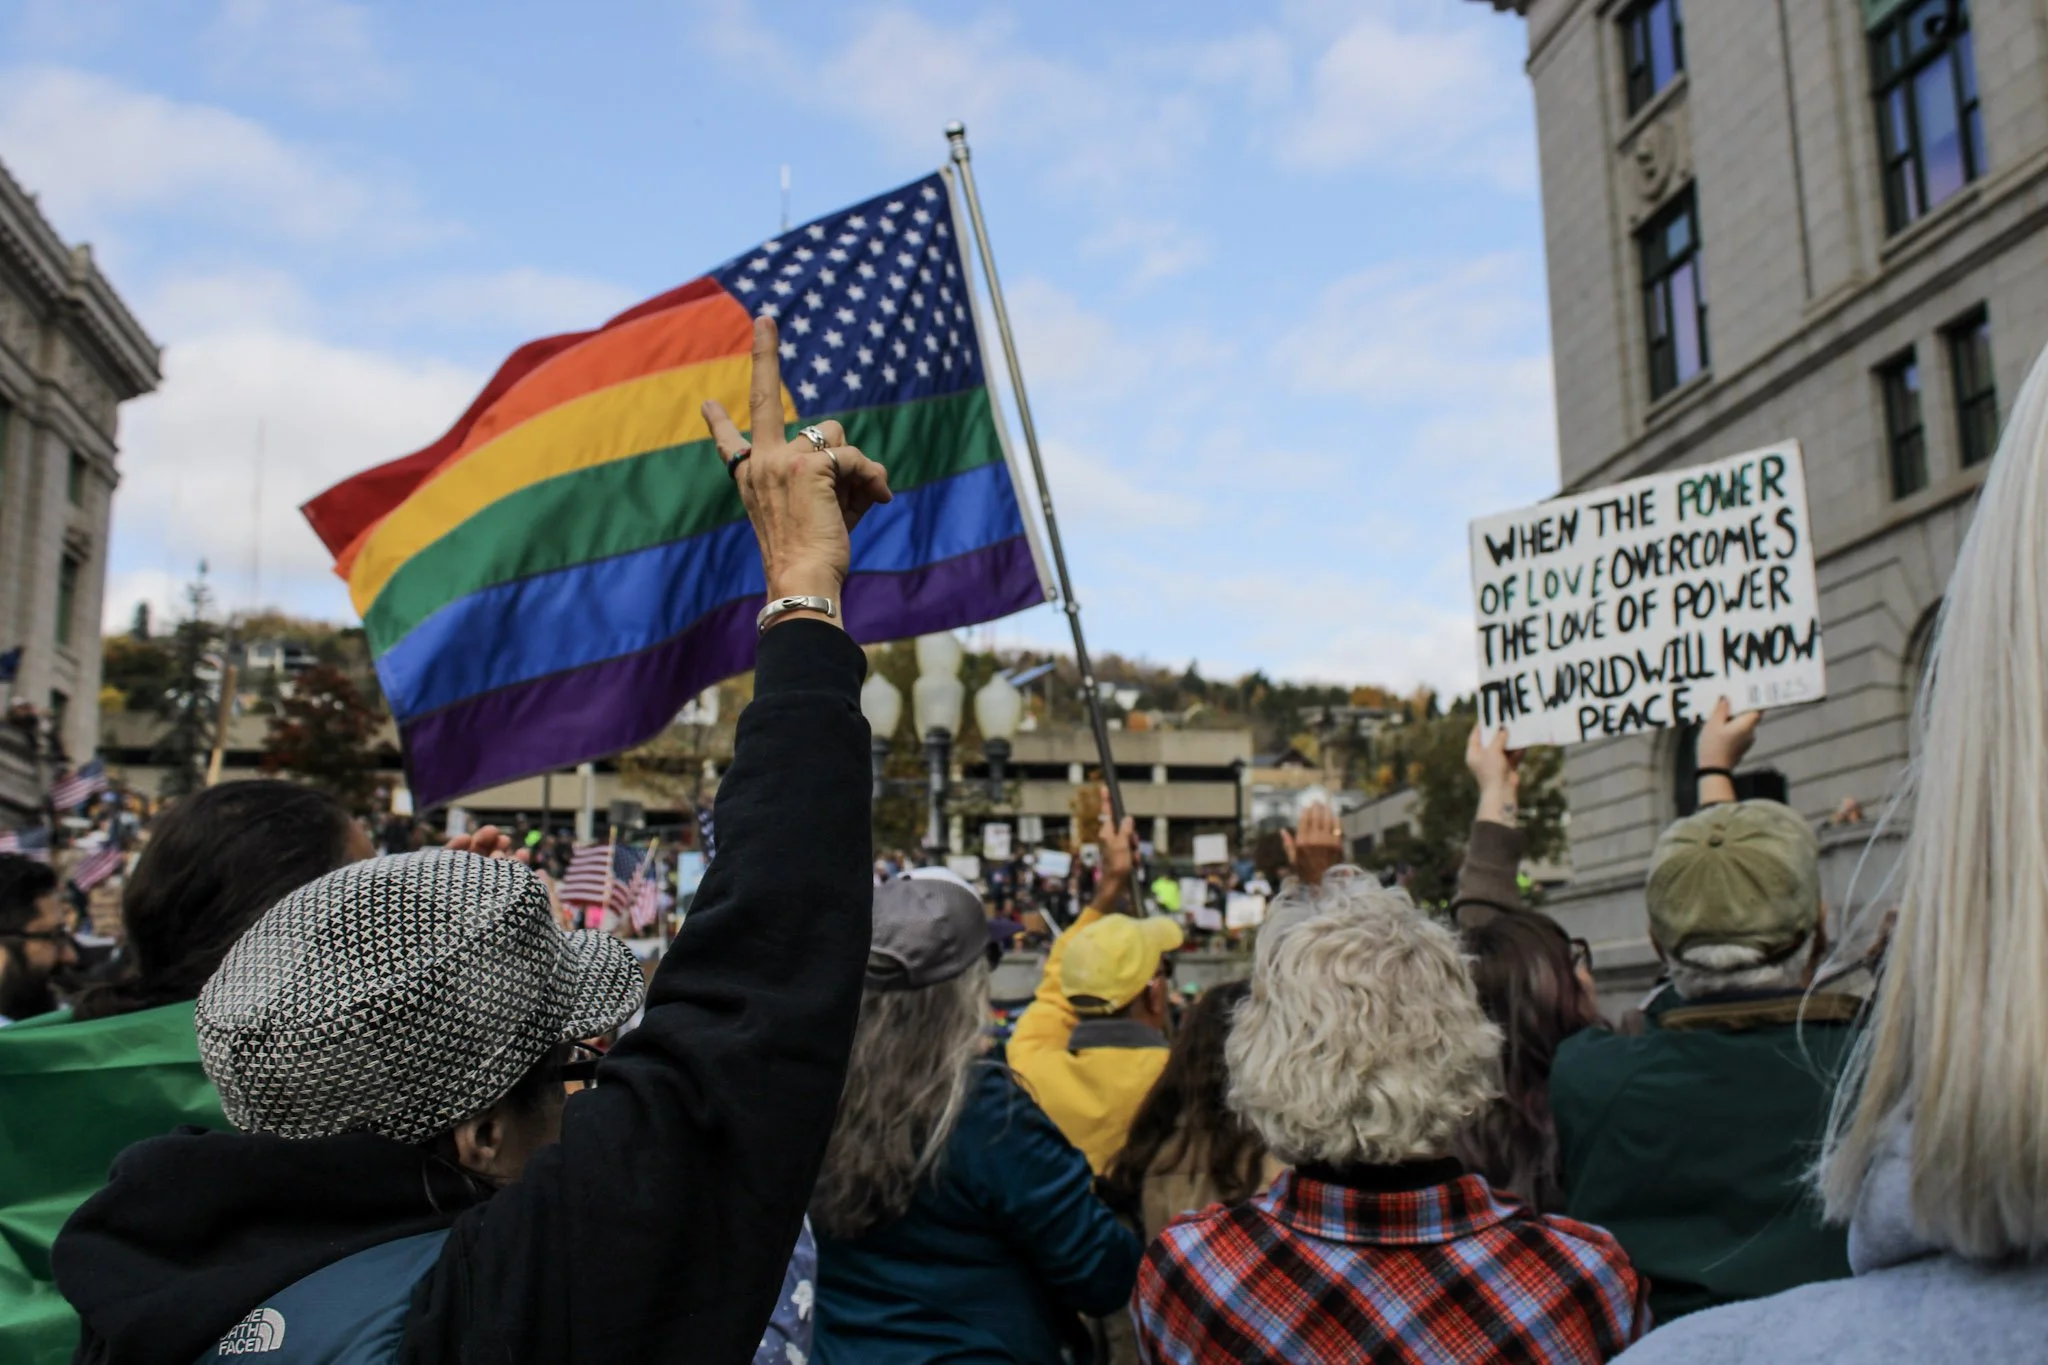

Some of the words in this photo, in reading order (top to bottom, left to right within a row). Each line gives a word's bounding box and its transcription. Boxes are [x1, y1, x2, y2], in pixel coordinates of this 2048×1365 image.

[1480, 575, 1517, 615] OF
[1527, 556, 1605, 608] LOVE
[1611, 507, 1797, 588] OVERCOMES
[1485, 510, 1578, 566] WHEN
[1589, 490, 1655, 537] THE
[1678, 455, 1785, 521] POWER
[1479, 615, 1538, 667] THE
[1546, 602, 1606, 650] LOVE
[1617, 589, 1658, 632] OF
[1675, 566, 1793, 626] POWER
[1480, 673, 1530, 727] THE
[1535, 655, 1635, 708] WORLD
[1637, 633, 1715, 684] WILL
[1722, 617, 1817, 678] KNOW
[219, 1338, 256, 1355] FACE
[220, 1323, 260, 1341] RTH
[241, 1308, 264, 1323] HE
